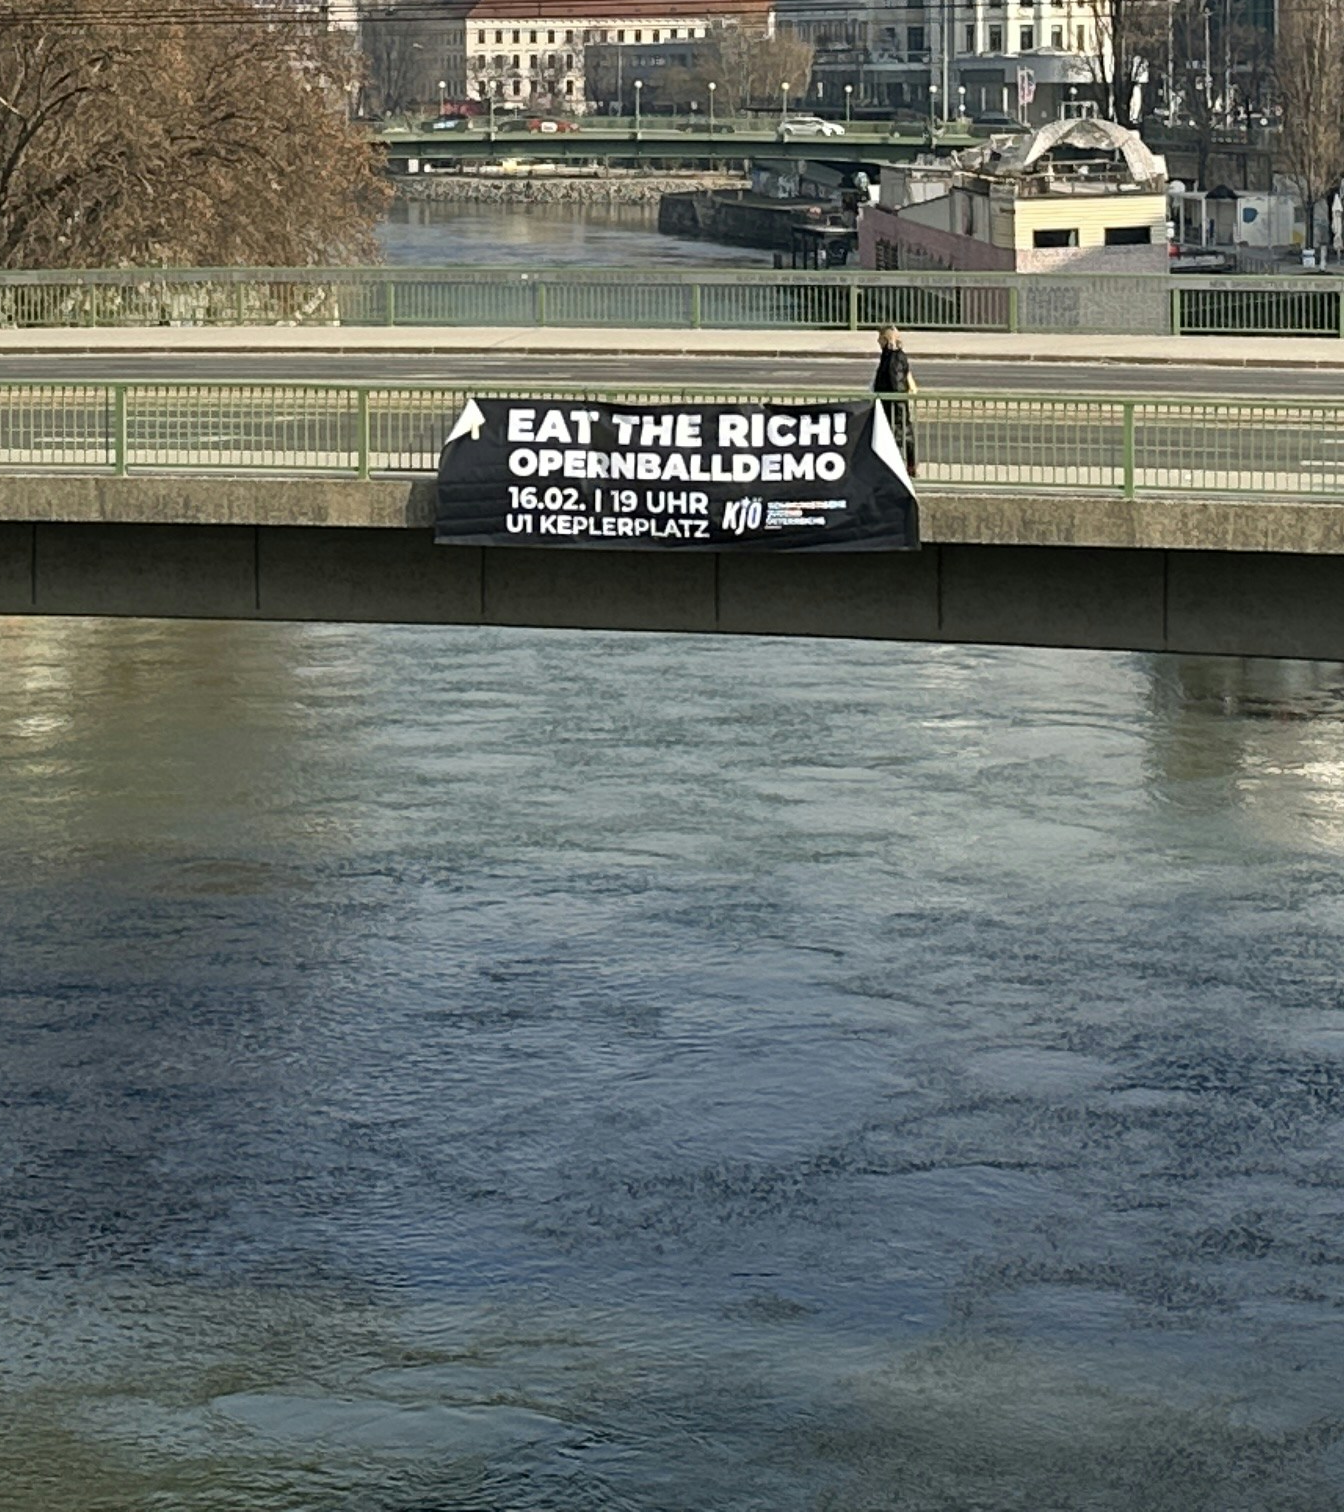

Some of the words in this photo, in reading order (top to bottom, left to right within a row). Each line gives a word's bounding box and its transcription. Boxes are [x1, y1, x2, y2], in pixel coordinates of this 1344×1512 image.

[507, 408, 600, 444] EAT
[612, 413, 703, 448] THE
[718, 412, 848, 448] RICH!
[508, 447, 846, 483] OPERNBALLDEMO
[508, 486, 587, 511] 16.02.
[610, 490, 638, 513] 19
[646, 490, 709, 515] UHR
[506, 513, 533, 533] U1
[540, 514, 710, 538] KEPLERPLATZ
